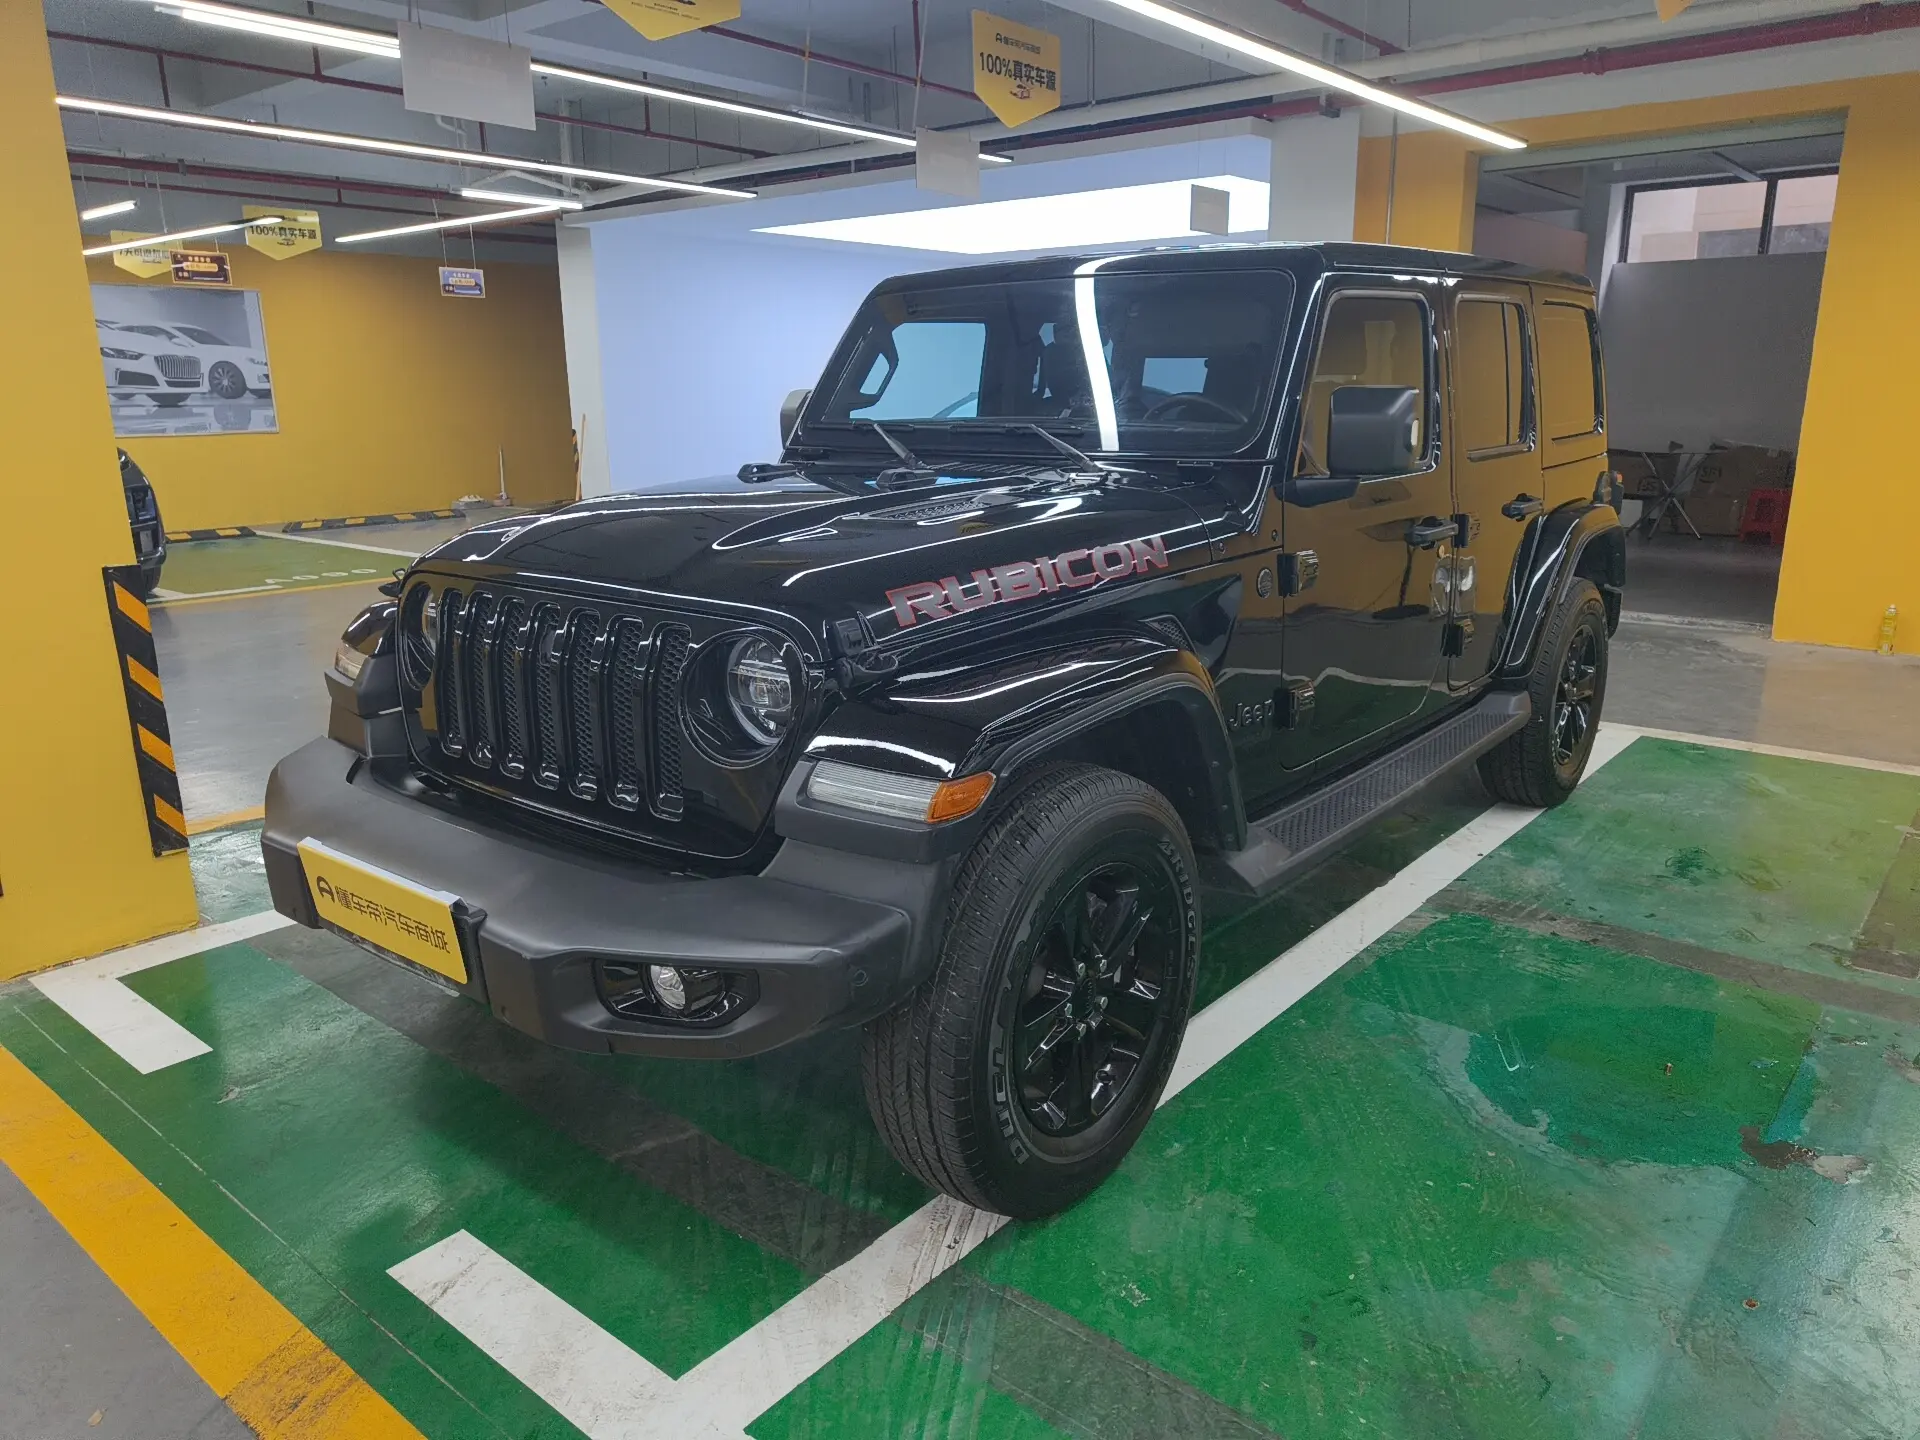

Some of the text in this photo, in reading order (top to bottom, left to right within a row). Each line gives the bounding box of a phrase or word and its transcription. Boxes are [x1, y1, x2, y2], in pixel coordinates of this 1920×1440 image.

[980, 51, 1057, 91] 100%真实车源
[885, 534, 1169, 627] RUBICON
[1228, 699, 1275, 732] Jeep
[335, 885, 451, 954] 懂车帝汽车商城
